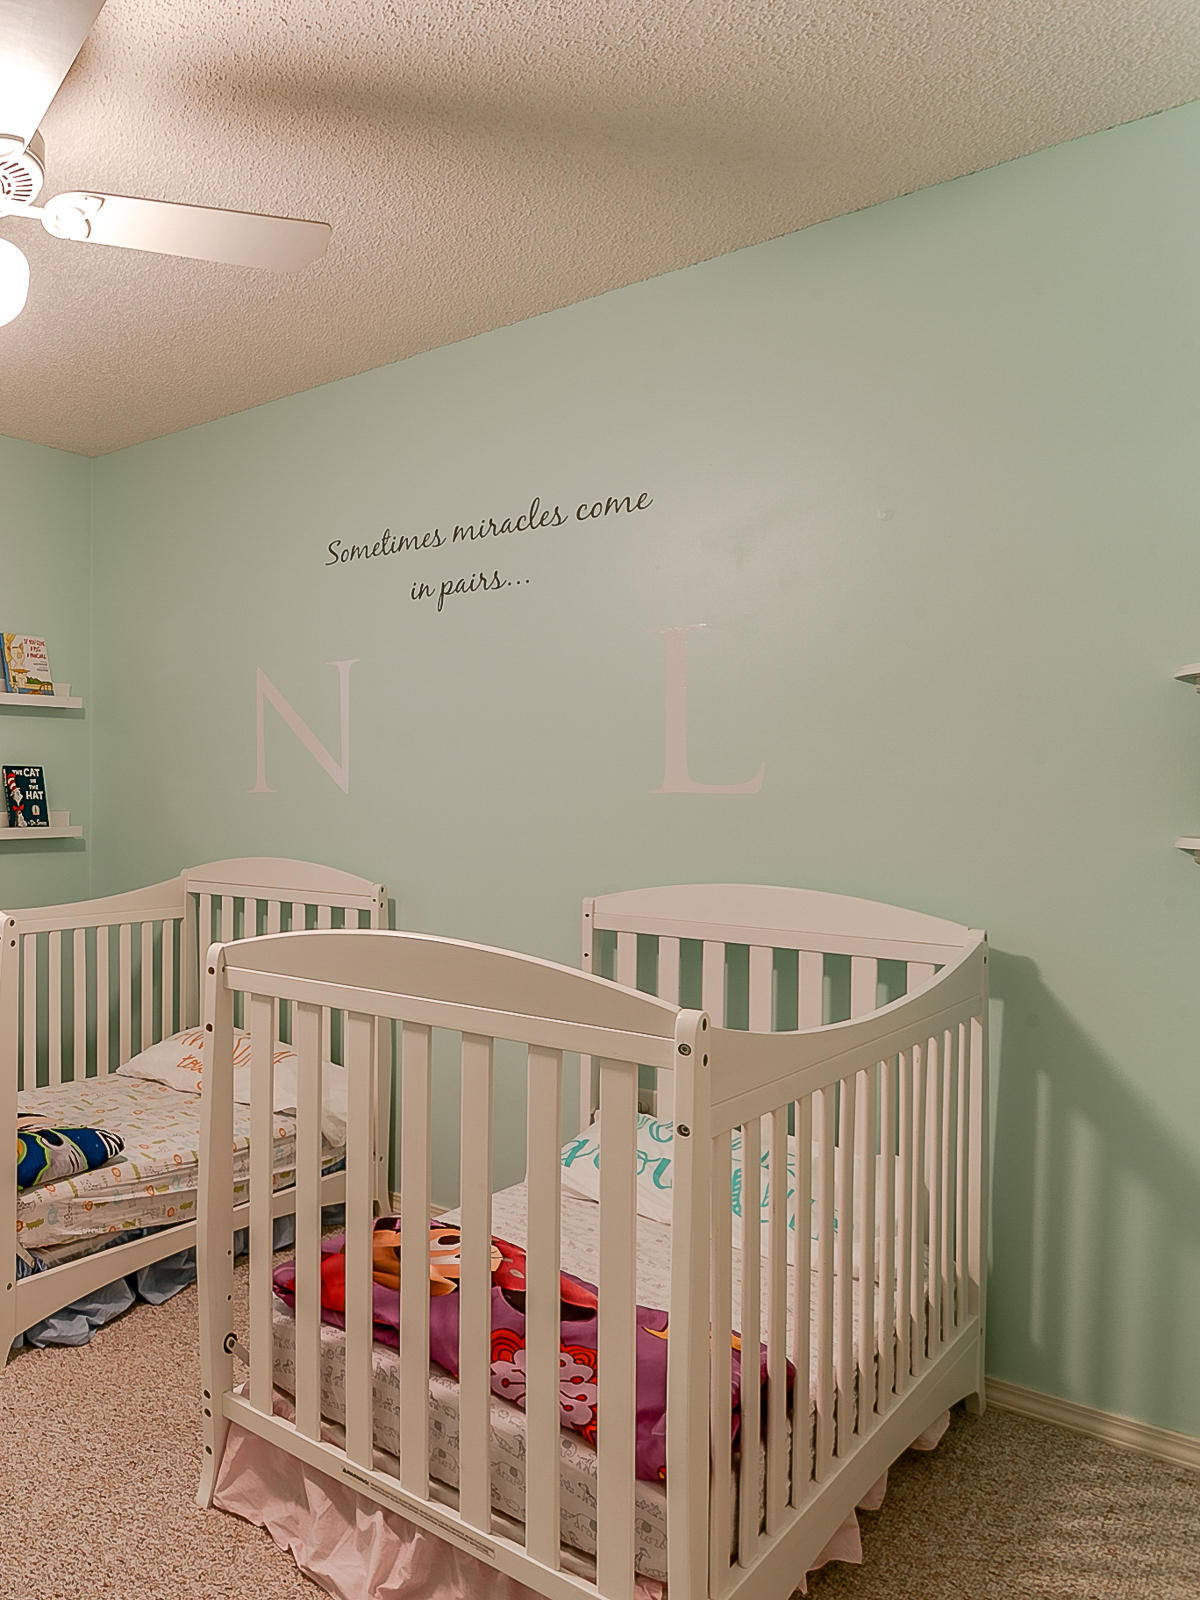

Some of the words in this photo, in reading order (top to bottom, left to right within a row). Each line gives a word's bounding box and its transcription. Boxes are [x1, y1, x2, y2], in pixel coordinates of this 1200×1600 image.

[325, 528, 447, 566] Sometimes
[452, 497, 569, 543] miracles
[576, 492, 654, 521] come
[410, 581, 436, 600] in
[247, 658, 361, 794] N
[643, 623, 767, 794] L
[23, 768, 40, 777] CAT
[25, 790, 44, 800] HAT
